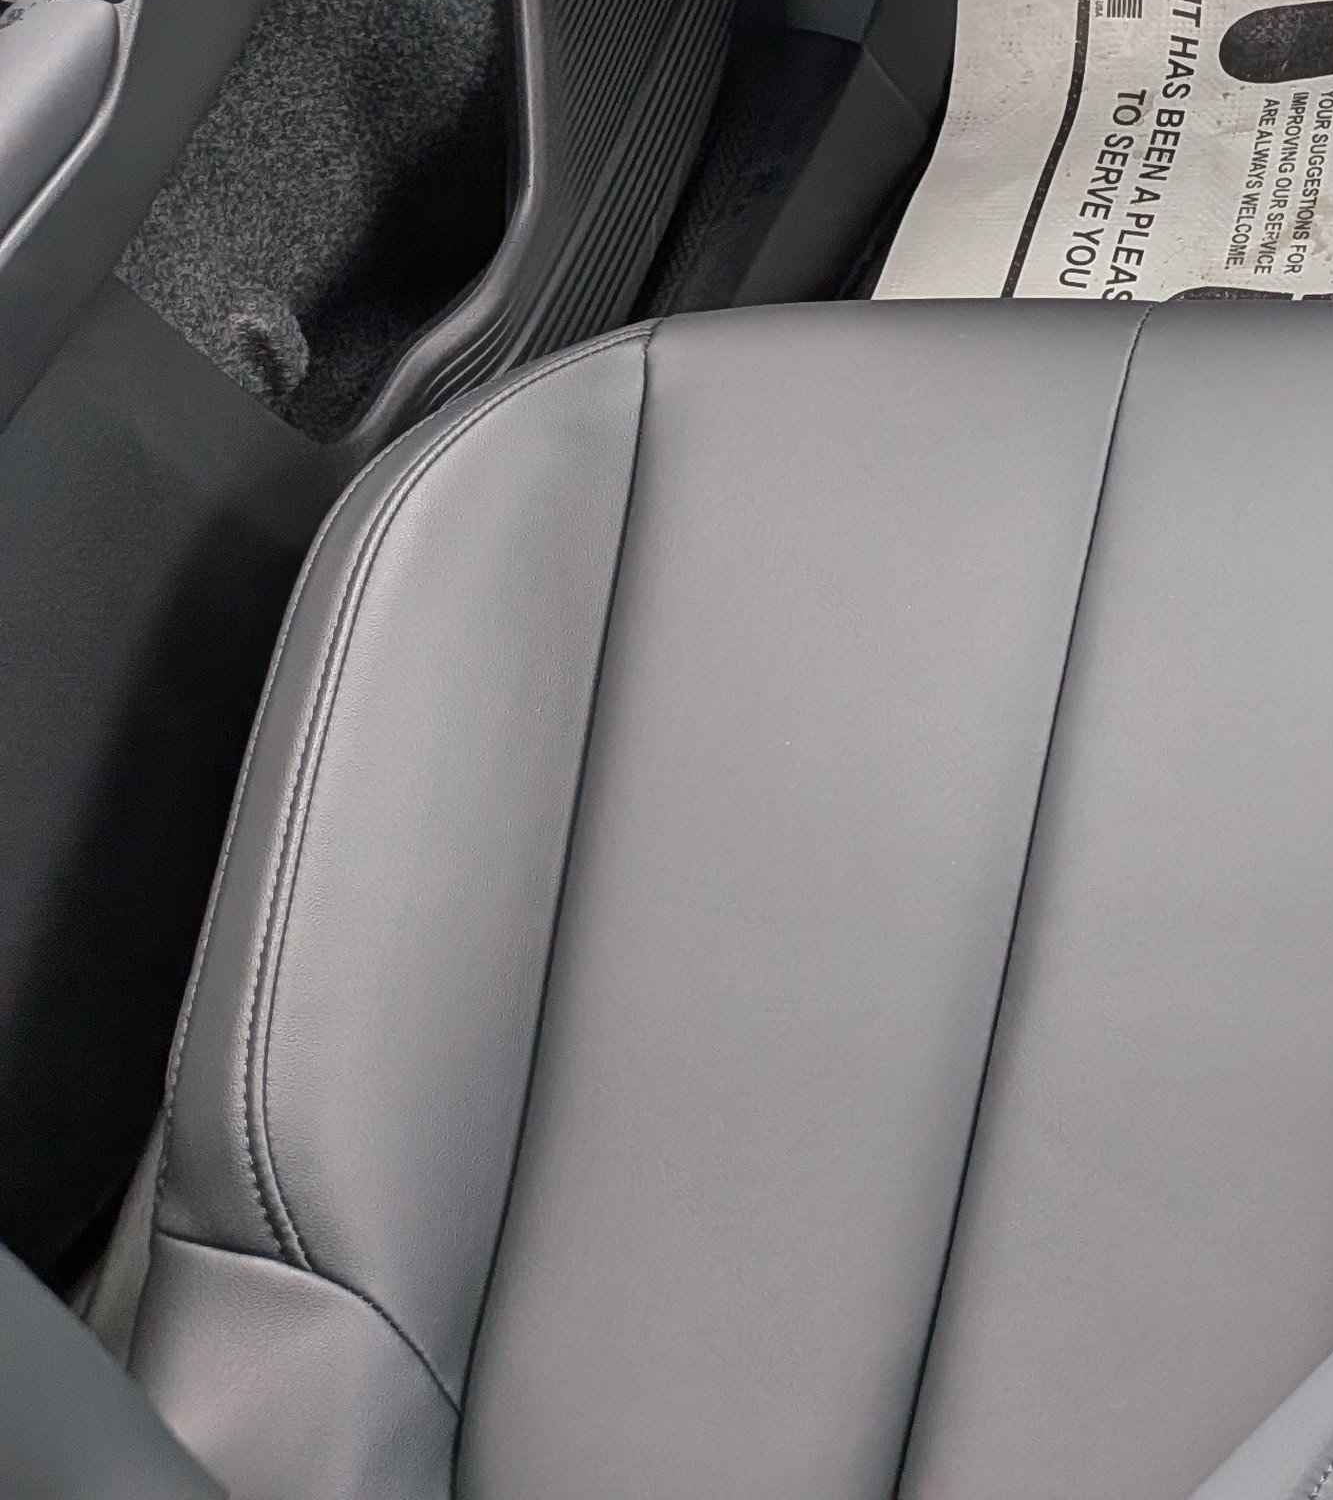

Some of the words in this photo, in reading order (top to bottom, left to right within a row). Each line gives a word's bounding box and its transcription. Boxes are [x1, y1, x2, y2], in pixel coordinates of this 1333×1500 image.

[1095, 0, 1104, 18] USA
[1162, 34, 1199, 99] HAS
[1112, 89, 1147, 126] TO
[1258, 98, 1281, 128] ARE
[1278, 91, 1310, 174] IMPROVING
[1138, 108, 1186, 181] BEEN
[1245, 129, 1273, 190] ALWAYS
[1079, 133, 1134, 220] SERVE
[1129, 186, 1162, 205] A
[1269, 177, 1292, 210] OUR
[1292, 132, 1329, 242] SUGGESTIONS
[1059, 227, 1105, 289] YOU
[1224, 191, 1261, 271] WELCOME.
[1254, 212, 1285, 276] SERVICE
[1284, 244, 1307, 275] FOR
